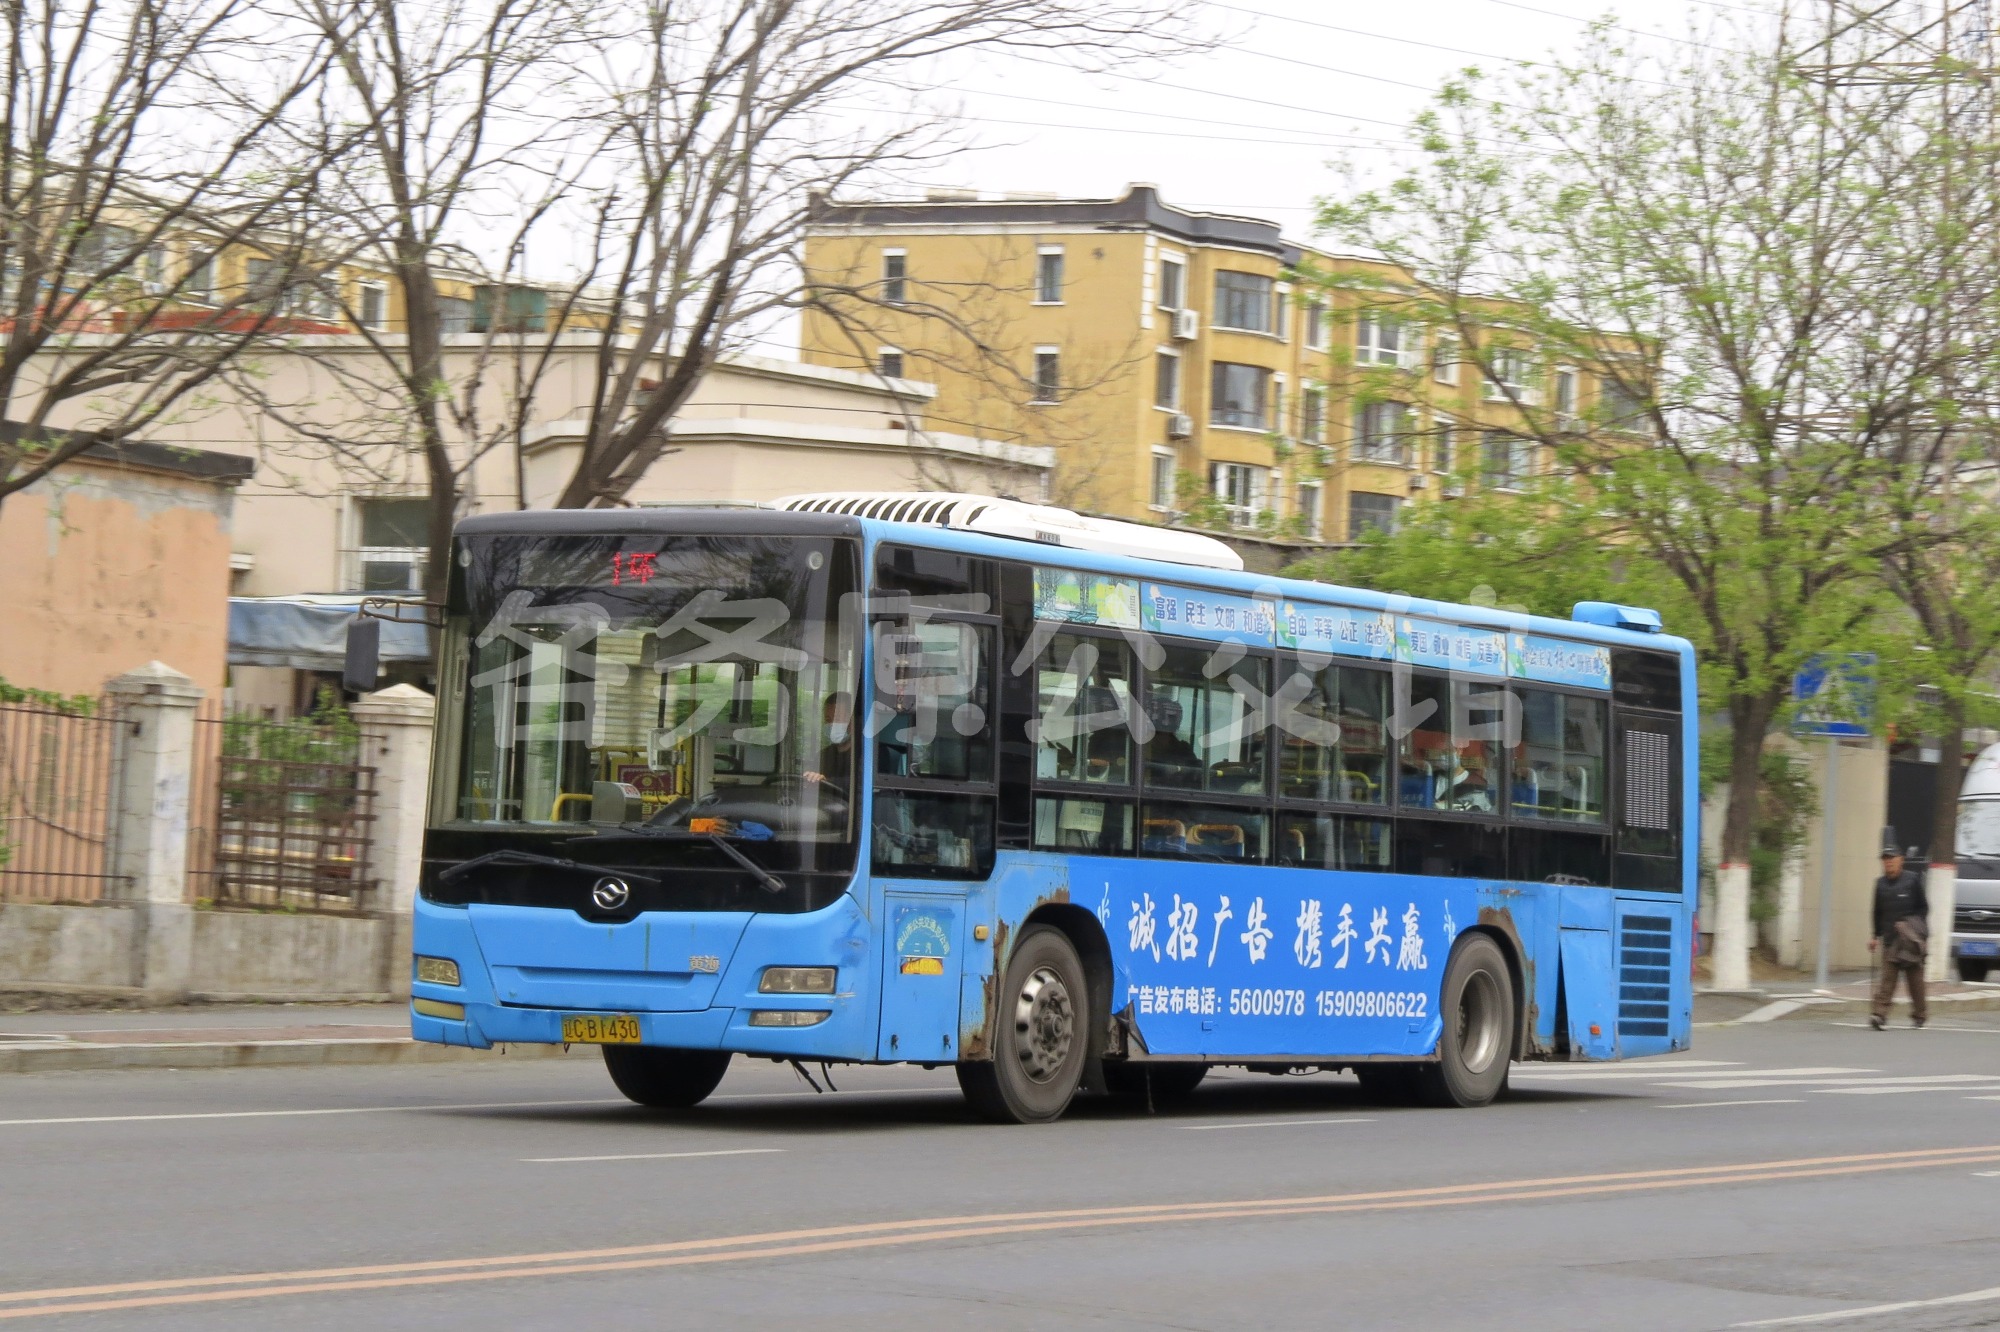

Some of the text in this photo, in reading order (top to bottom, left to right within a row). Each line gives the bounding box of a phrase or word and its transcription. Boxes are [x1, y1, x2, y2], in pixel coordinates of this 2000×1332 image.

[1155, 596, 1177, 621] 富强
[1185, 602, 1206, 626] 民主
[1214, 605, 1235, 630] 文明
[1242, 610, 1265, 635] 和谐
[1288, 614, 1385, 646] 自由 平等 公正 法治
[1410, 630, 1495, 664] 爱国 敬业 诚信 友善
[1127, 892, 1428, 971] 诚招广告 携手共赢
[688, 954, 720, 973] 黄海
[1229, 987, 1306, 1016] 5600978
[1315, 990, 1427, 1018] 15909806622
